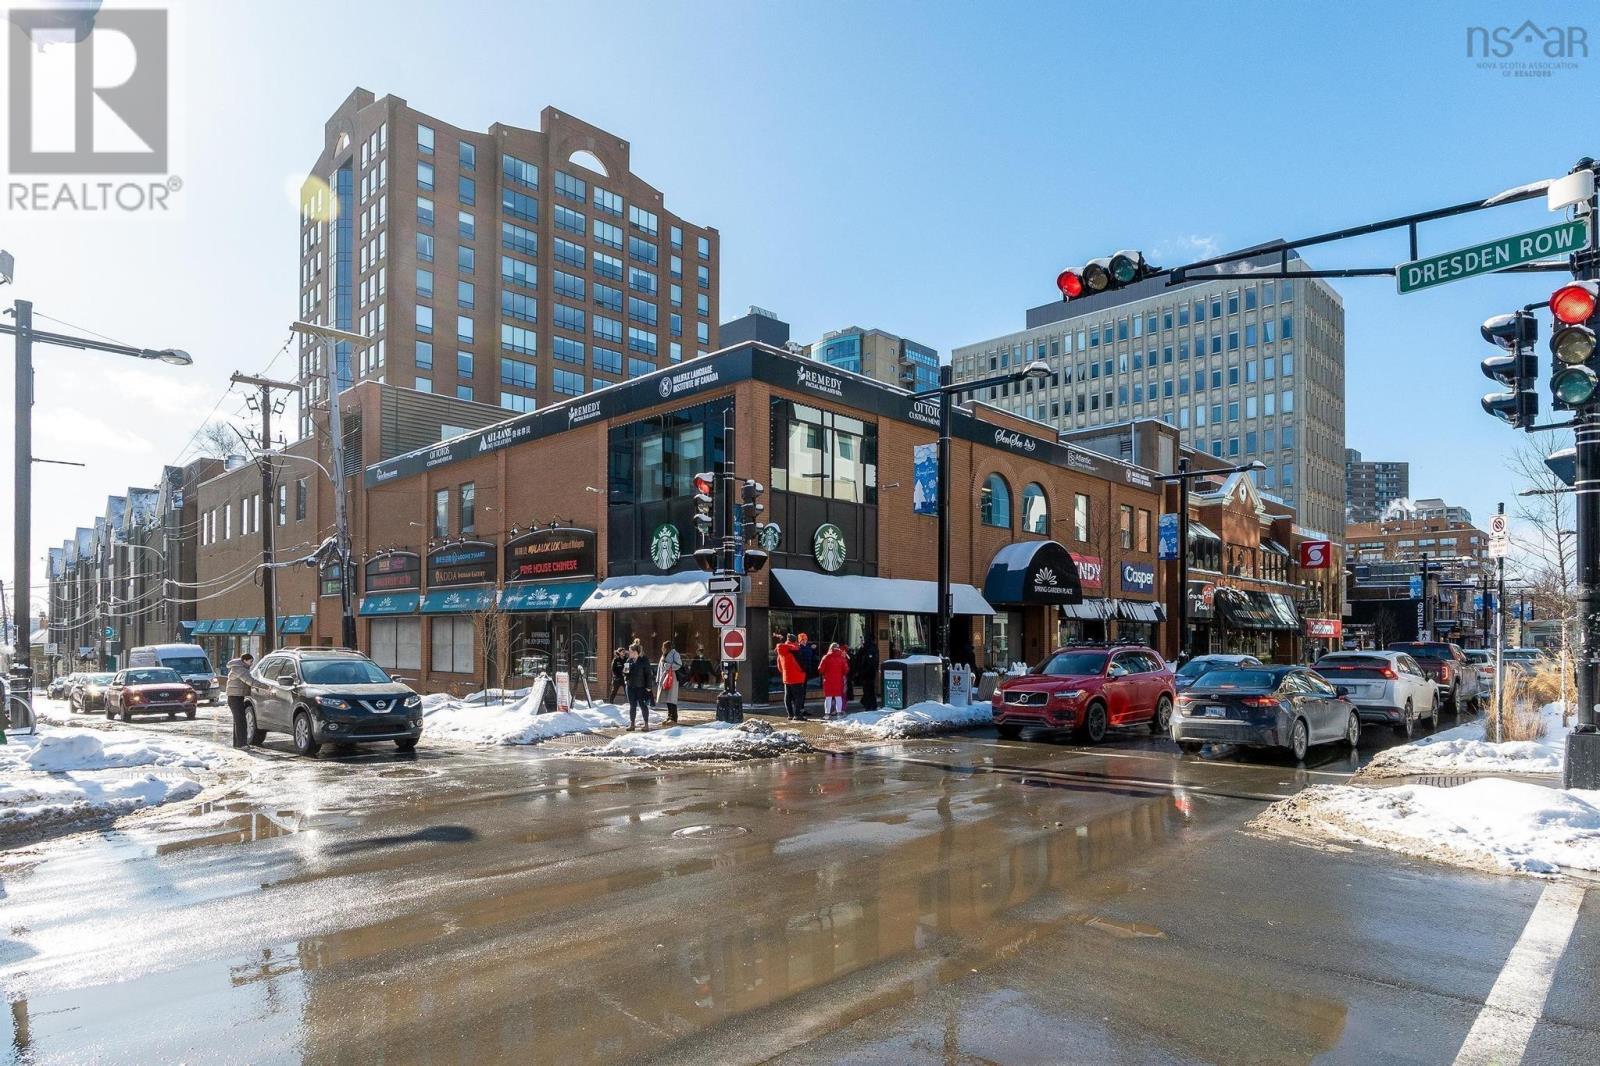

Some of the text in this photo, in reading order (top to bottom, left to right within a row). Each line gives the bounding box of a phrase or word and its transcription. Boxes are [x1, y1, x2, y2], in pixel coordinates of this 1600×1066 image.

[1408, 226, 1574, 287] DRESDEN ROW
[672, 371, 691, 384] HALIFAX
[700, 372, 719, 385] CANADA
[805, 370, 842, 390] REMEDY
[574, 401, 601, 416] REMEDY
[1075, 454, 1092, 465] Atlantic
[533, 563, 552, 574] HOUSE
[552, 560, 577, 571] CHINESE
[1074, 560, 1101, 581] NDY
[1124, 565, 1154, 589] Casper
